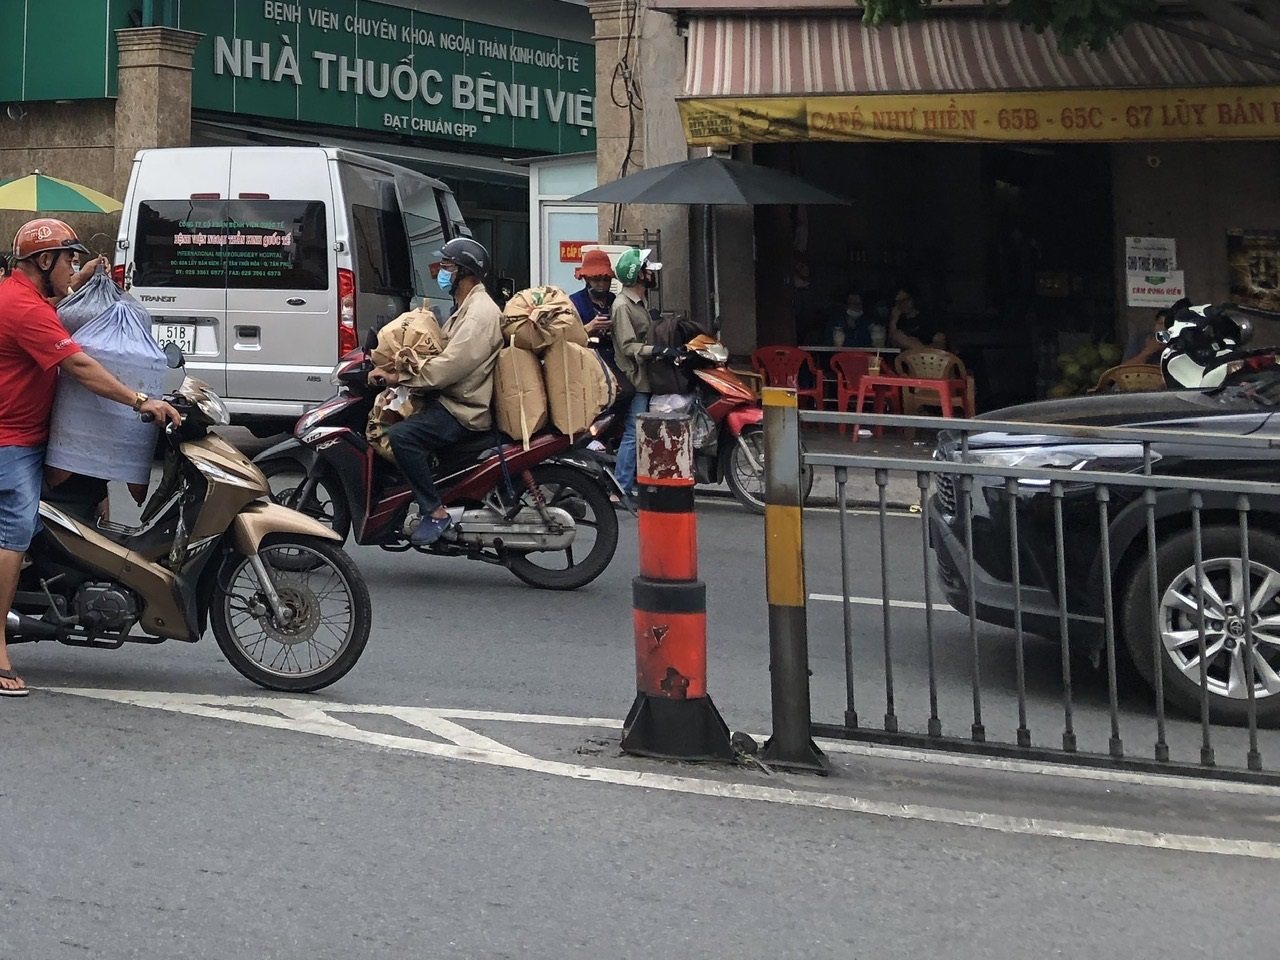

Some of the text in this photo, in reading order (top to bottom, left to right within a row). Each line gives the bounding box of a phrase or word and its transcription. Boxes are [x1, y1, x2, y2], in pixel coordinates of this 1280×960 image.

[264, 0, 301, 25] BỆNH
[308, 7, 339, 33] VIỆN
[344, 15, 397, 41] CHUYÊN
[401, 26, 435, 48] KHOA
[440, 32, 475, 57] NGOẠI
[509, 45, 534, 65] KINH
[214, 34, 596, 137] NHÀ THUỐC BỆNH VIỆ
[384, 113, 409, 131] ĐẠT
[454, 122, 477, 138] GPP
[810, 105, 865, 131] CAFÉ
[872, 107, 918, 130] NHƯ
[922, 98, 976, 130] HIỀN
[997, 108, 1040, 130] 65B
[1060, 106, 1103, 129] 65C
[1125, 105, 1154, 128] 67
[1161, 98, 1207, 126] LŨY
[627, 263, 637, 279] Grab
[166, 326, 186, 339] 51B
